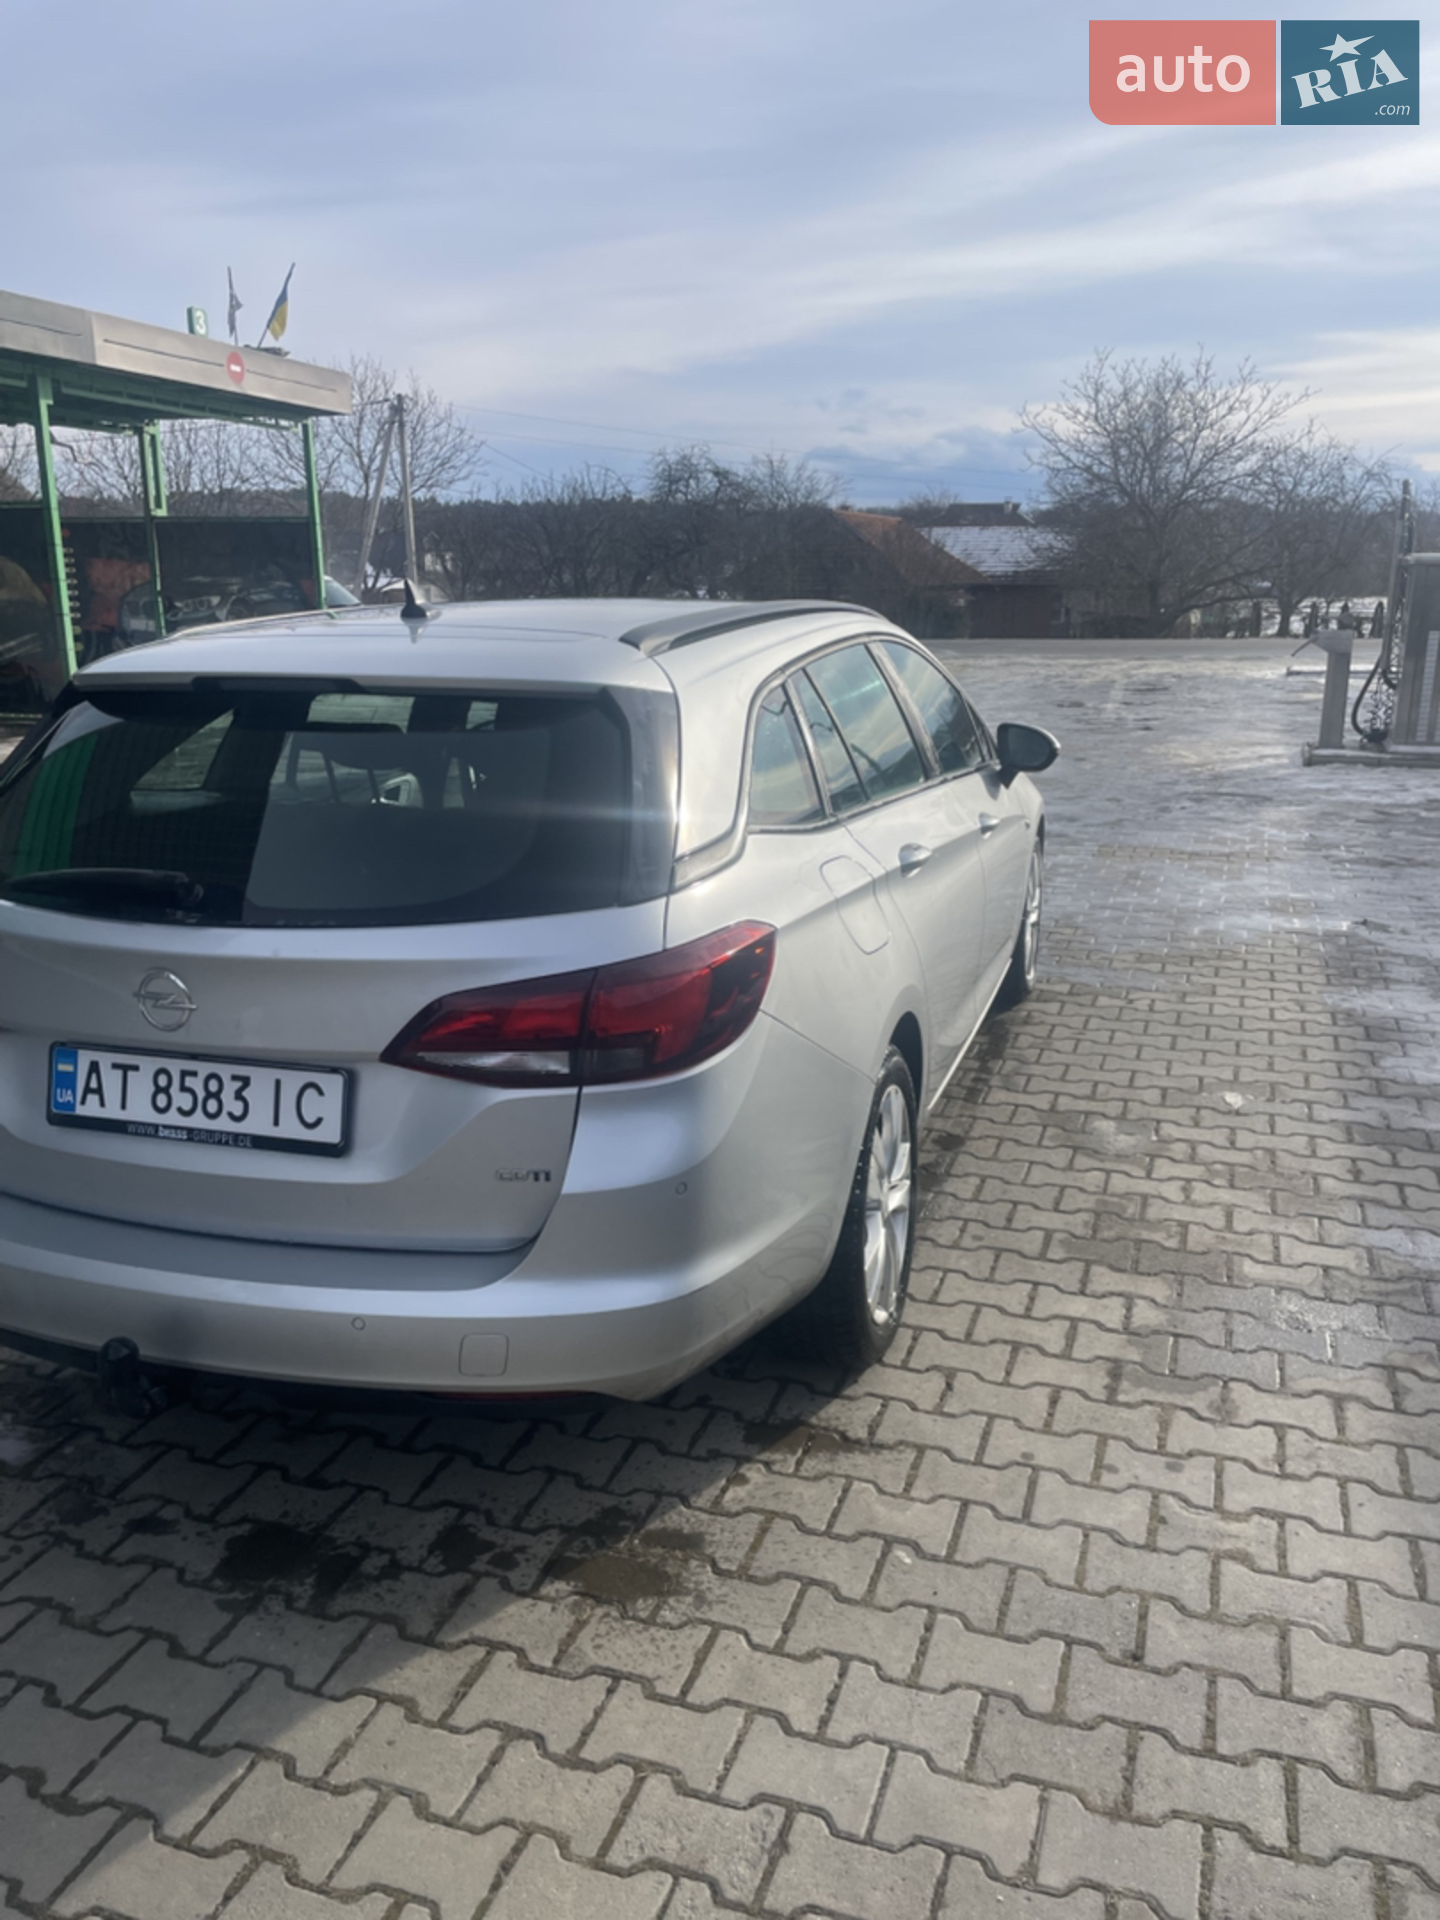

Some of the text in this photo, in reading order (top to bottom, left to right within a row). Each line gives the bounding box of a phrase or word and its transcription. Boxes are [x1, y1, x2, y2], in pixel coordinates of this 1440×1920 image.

[195, 310, 207, 335] 3
[56, 1088, 74, 1103] UA
[79, 1060, 325, 1130] AT 8583 IC
